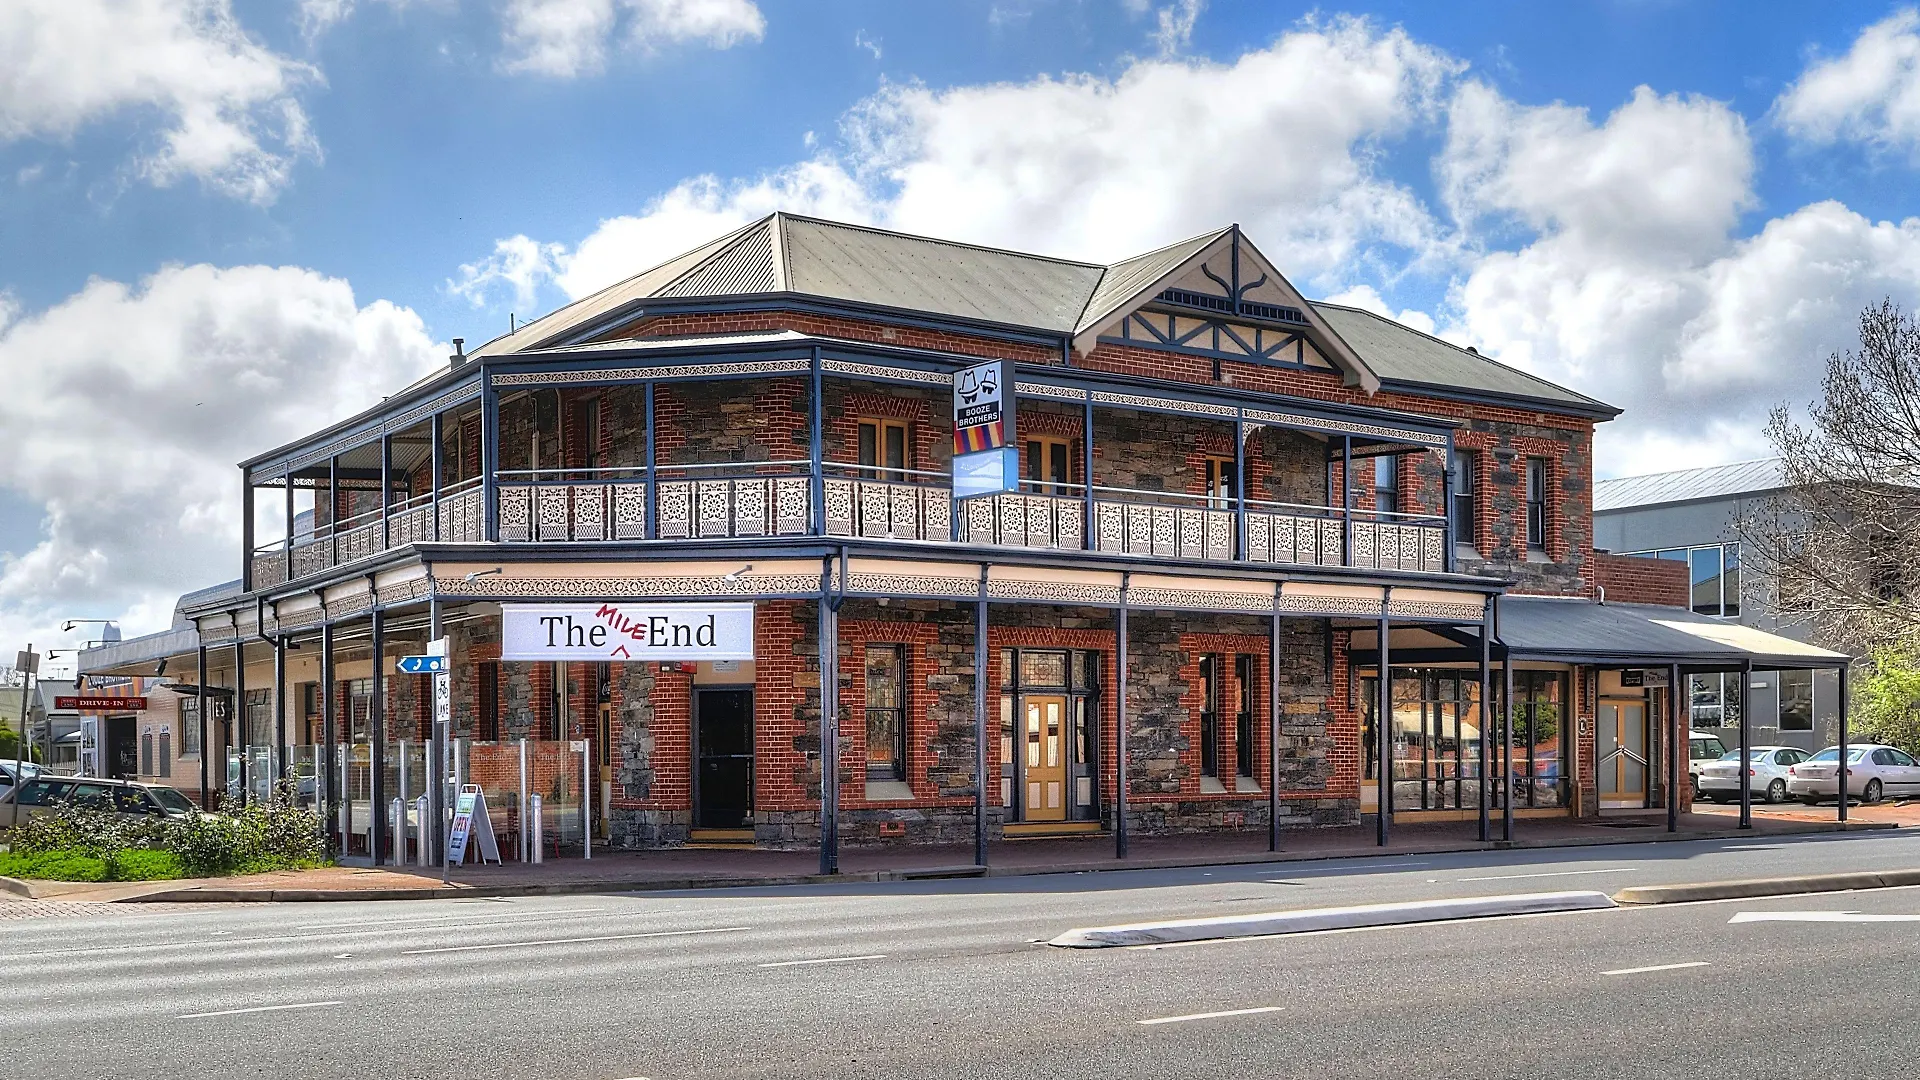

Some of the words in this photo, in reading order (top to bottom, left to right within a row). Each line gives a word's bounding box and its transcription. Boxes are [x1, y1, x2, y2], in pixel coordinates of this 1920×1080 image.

[965, 405, 991, 416] BOOZE
[959, 412, 998, 427] BROTHERS
[540, 615, 607, 647] The
[595, 604, 648, 640] MILE
[647, 615, 717, 647] End
[437, 703, 449, 716] LANE
